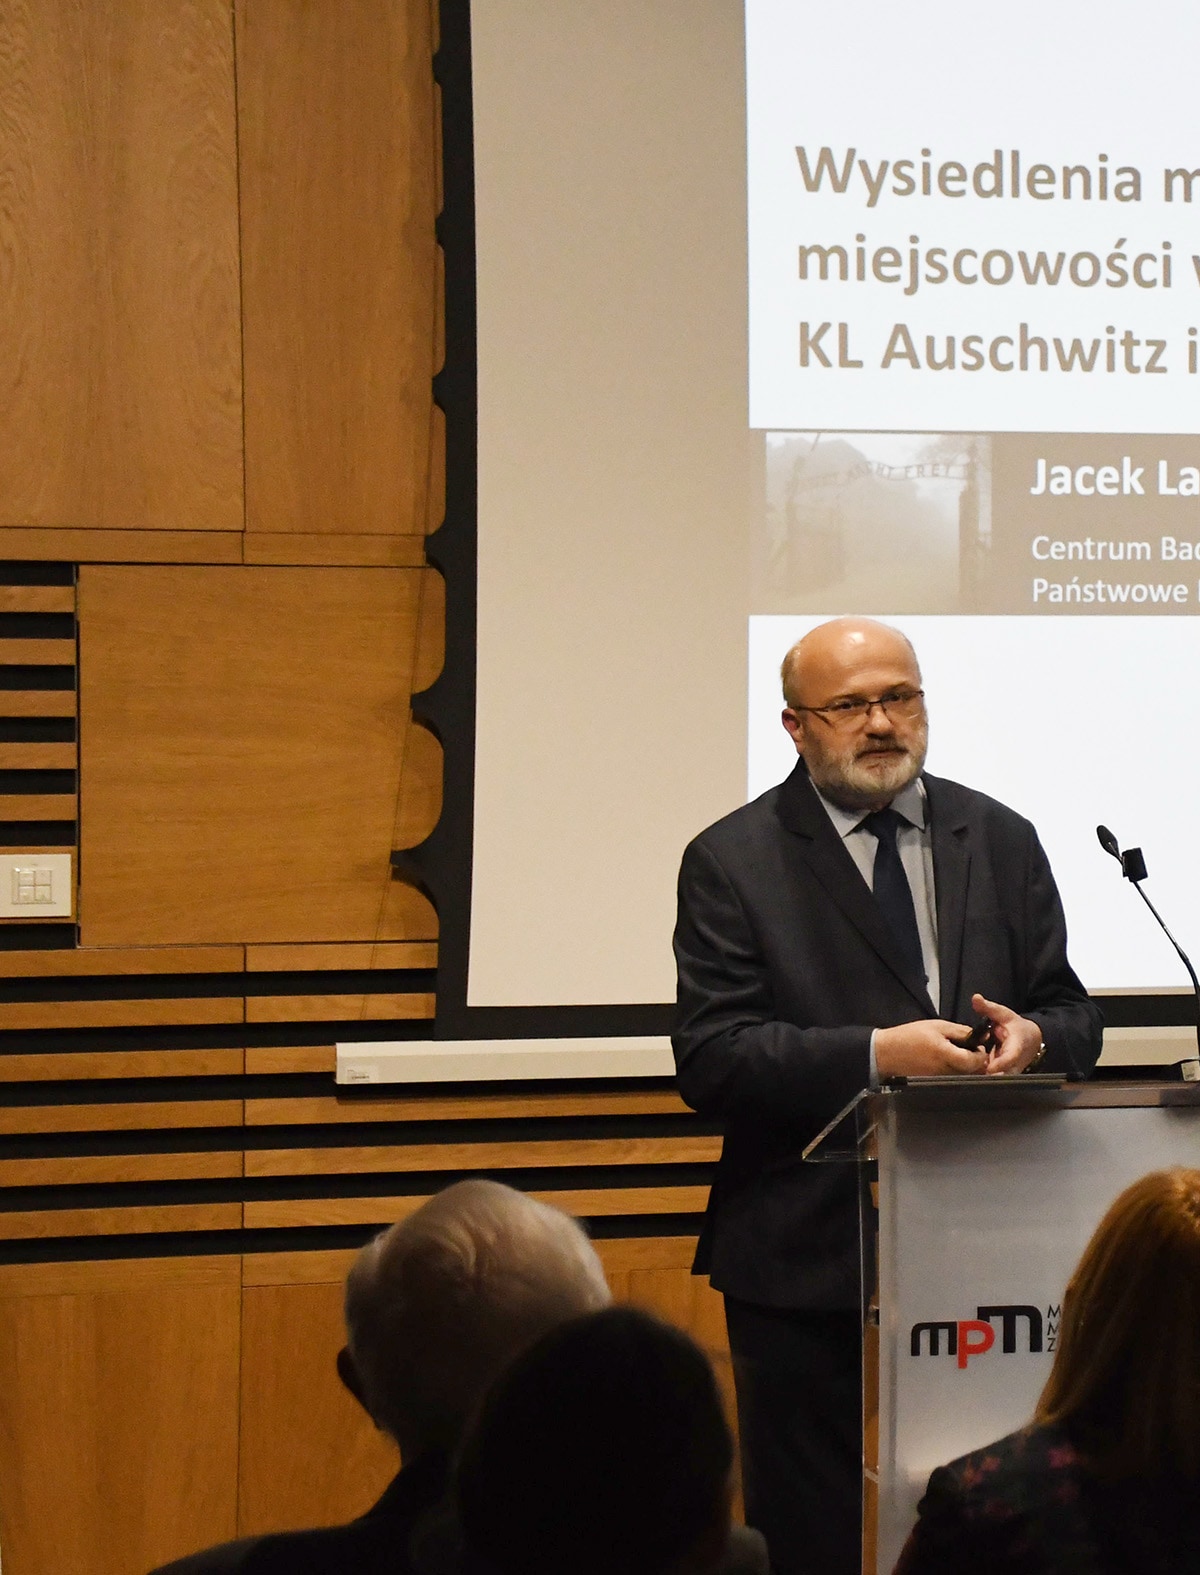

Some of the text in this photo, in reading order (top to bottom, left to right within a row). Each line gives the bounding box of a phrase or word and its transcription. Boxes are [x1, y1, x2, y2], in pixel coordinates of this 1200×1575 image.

[795, 146, 1141, 208] Wysiedlenia
[799, 233, 1172, 296] miejscowości
[800, 322, 863, 368] KL
[881, 323, 1167, 374] Auschwitz
[1188, 327, 1197, 374] i
[1031, 457, 1144, 495] Jacek
[1032, 536, 1150, 560] Centrum
[1034, 577, 1188, 602] Państwowe
